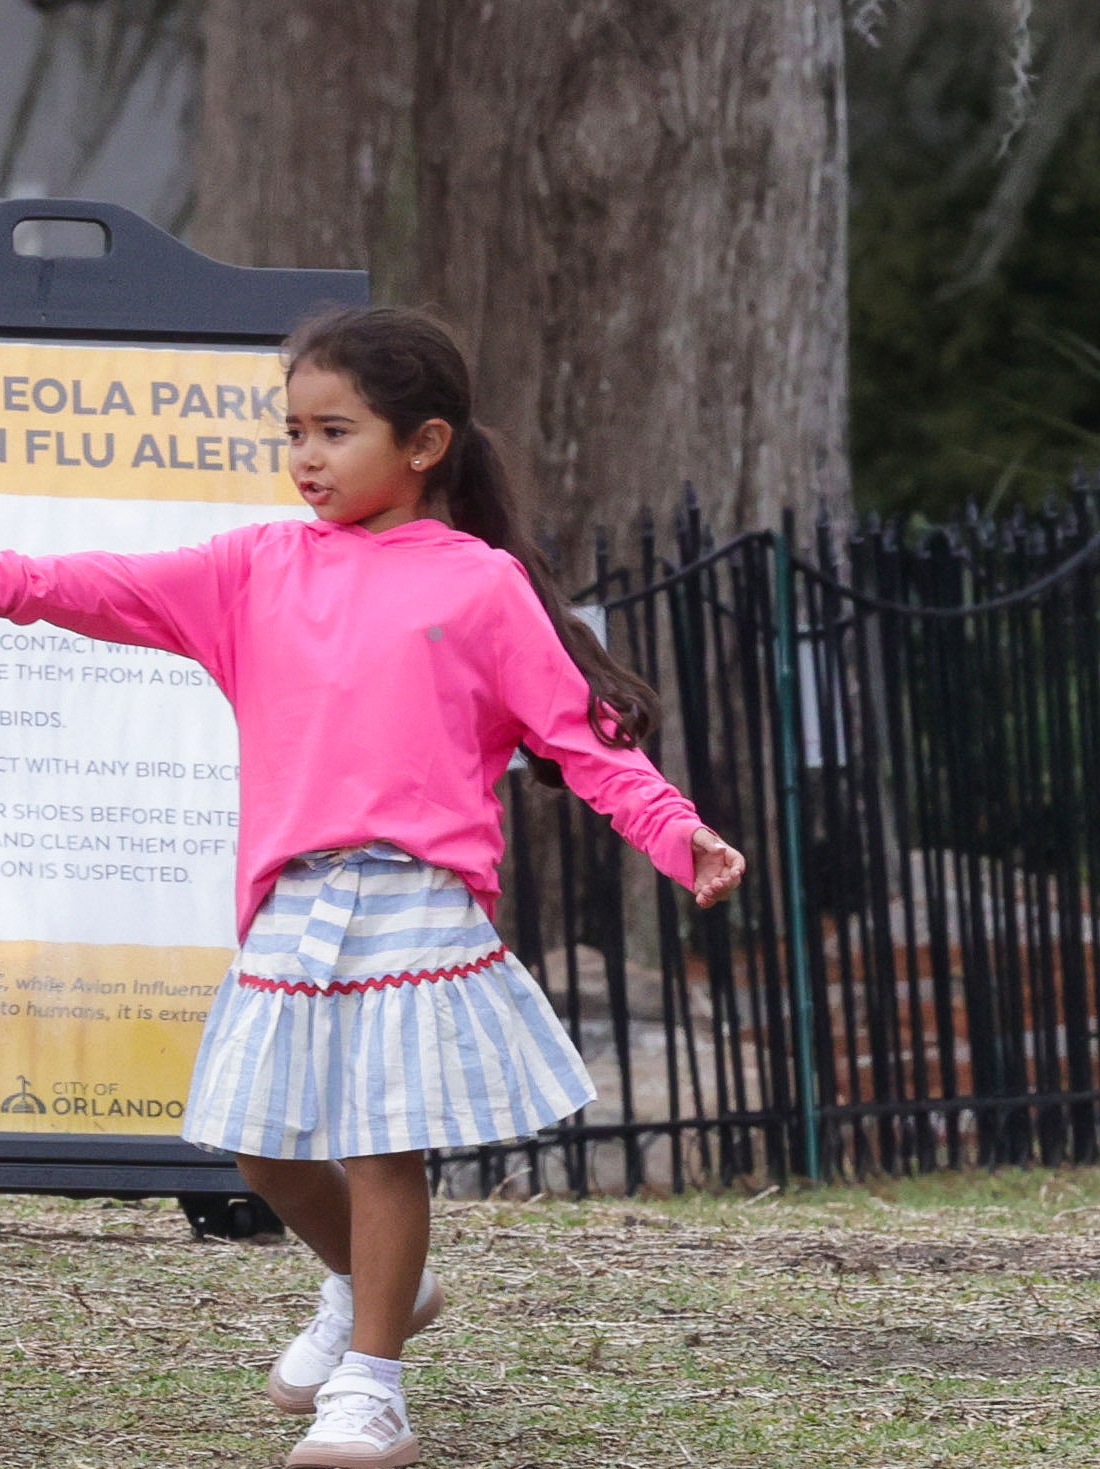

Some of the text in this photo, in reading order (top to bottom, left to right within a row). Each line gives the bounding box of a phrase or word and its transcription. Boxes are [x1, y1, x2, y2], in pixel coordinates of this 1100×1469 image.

[4, 376, 134, 416] EOLA
[150, 381, 285, 423] PARK
[26, 430, 115, 468] FLU
[131, 434, 288, 473] ALERT
[0, 634, 96, 653] CONTACT
[16, 665, 73, 682] THEM
[82, 667, 145, 684] FROM
[149, 669, 164, 684] A
[169, 670, 218, 687] DIST
[0, 712, 67, 728] BIRDS.
[27, 758, 80, 776] WITH
[85, 760, 130, 777] ANY
[136, 762, 187, 780] BIRD
[12, 804, 84, 821] SHOES
[91, 807, 177, 824] BEFORE
[40, 834, 111, 852] CLEAN
[116, 836, 177, 854] THEM
[183, 839, 227, 855] OFF
[39, 862, 59, 880] IS
[64, 864, 192, 884] SUSPECTED.
[0, 1002, 21, 1016] to
[117, 1004, 132, 1019] it
[137, 1006, 154, 1020] is
[52, 1081, 119, 1096] CITY OF
[52, 1097, 184, 1118] ORLANDO
